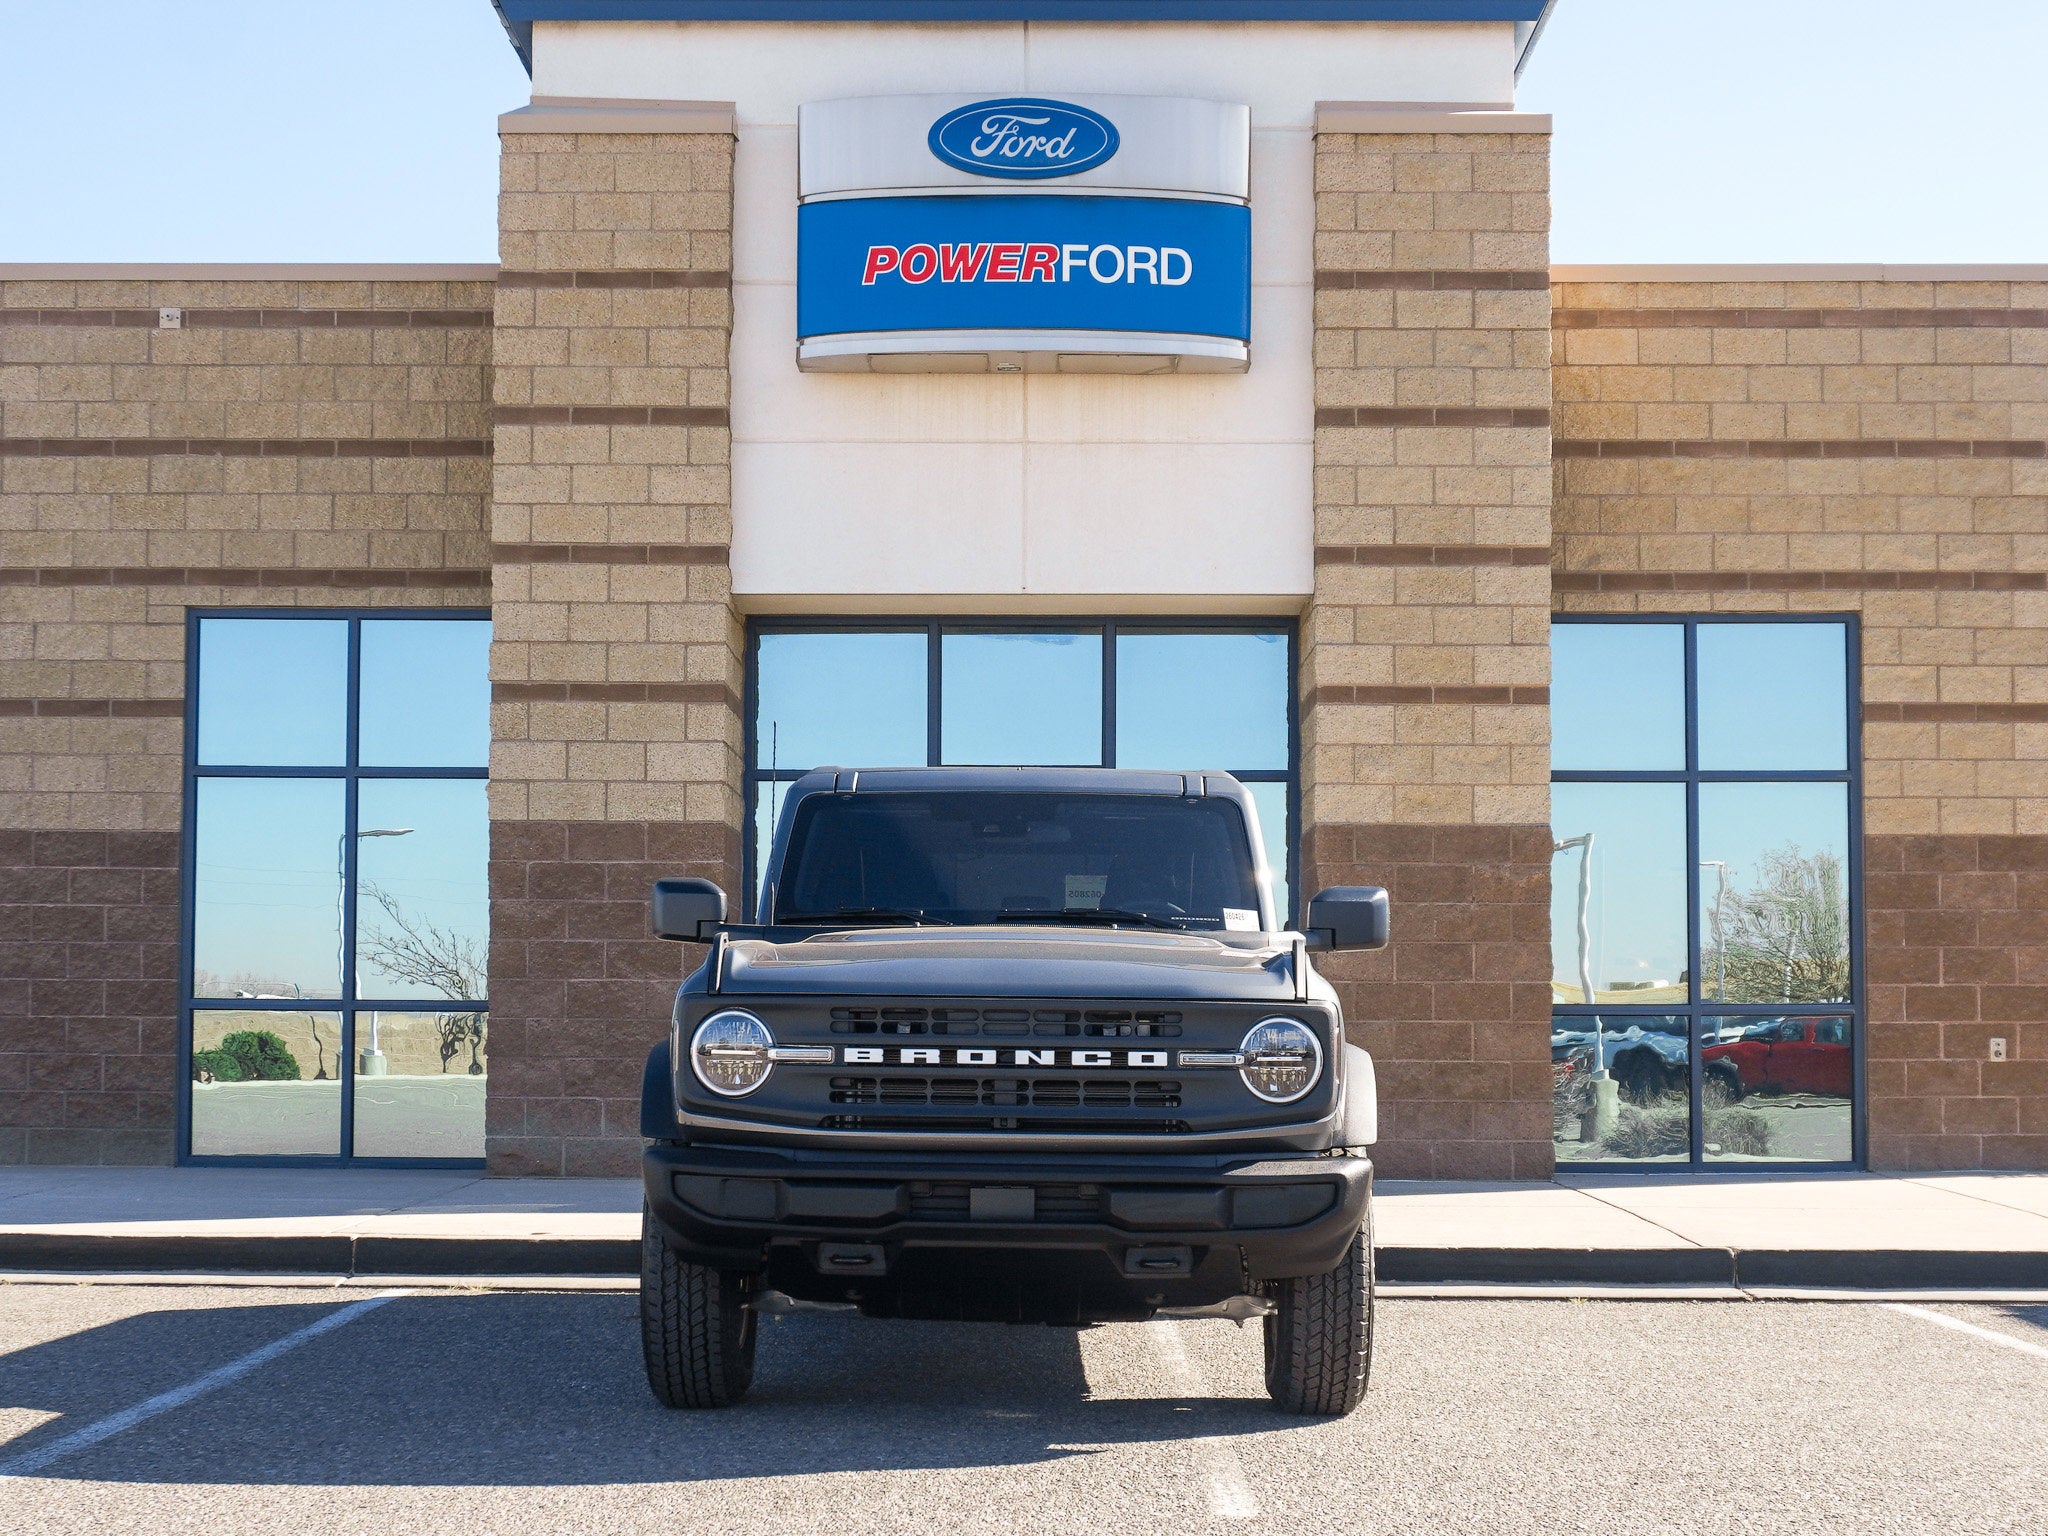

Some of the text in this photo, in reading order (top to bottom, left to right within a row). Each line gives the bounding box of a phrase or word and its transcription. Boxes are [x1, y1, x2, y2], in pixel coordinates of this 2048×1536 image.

[971, 115, 1077, 159] Ford
[861, 243, 1193, 285] POWERFORD
[844, 1047, 1168, 1067] BRONCO
